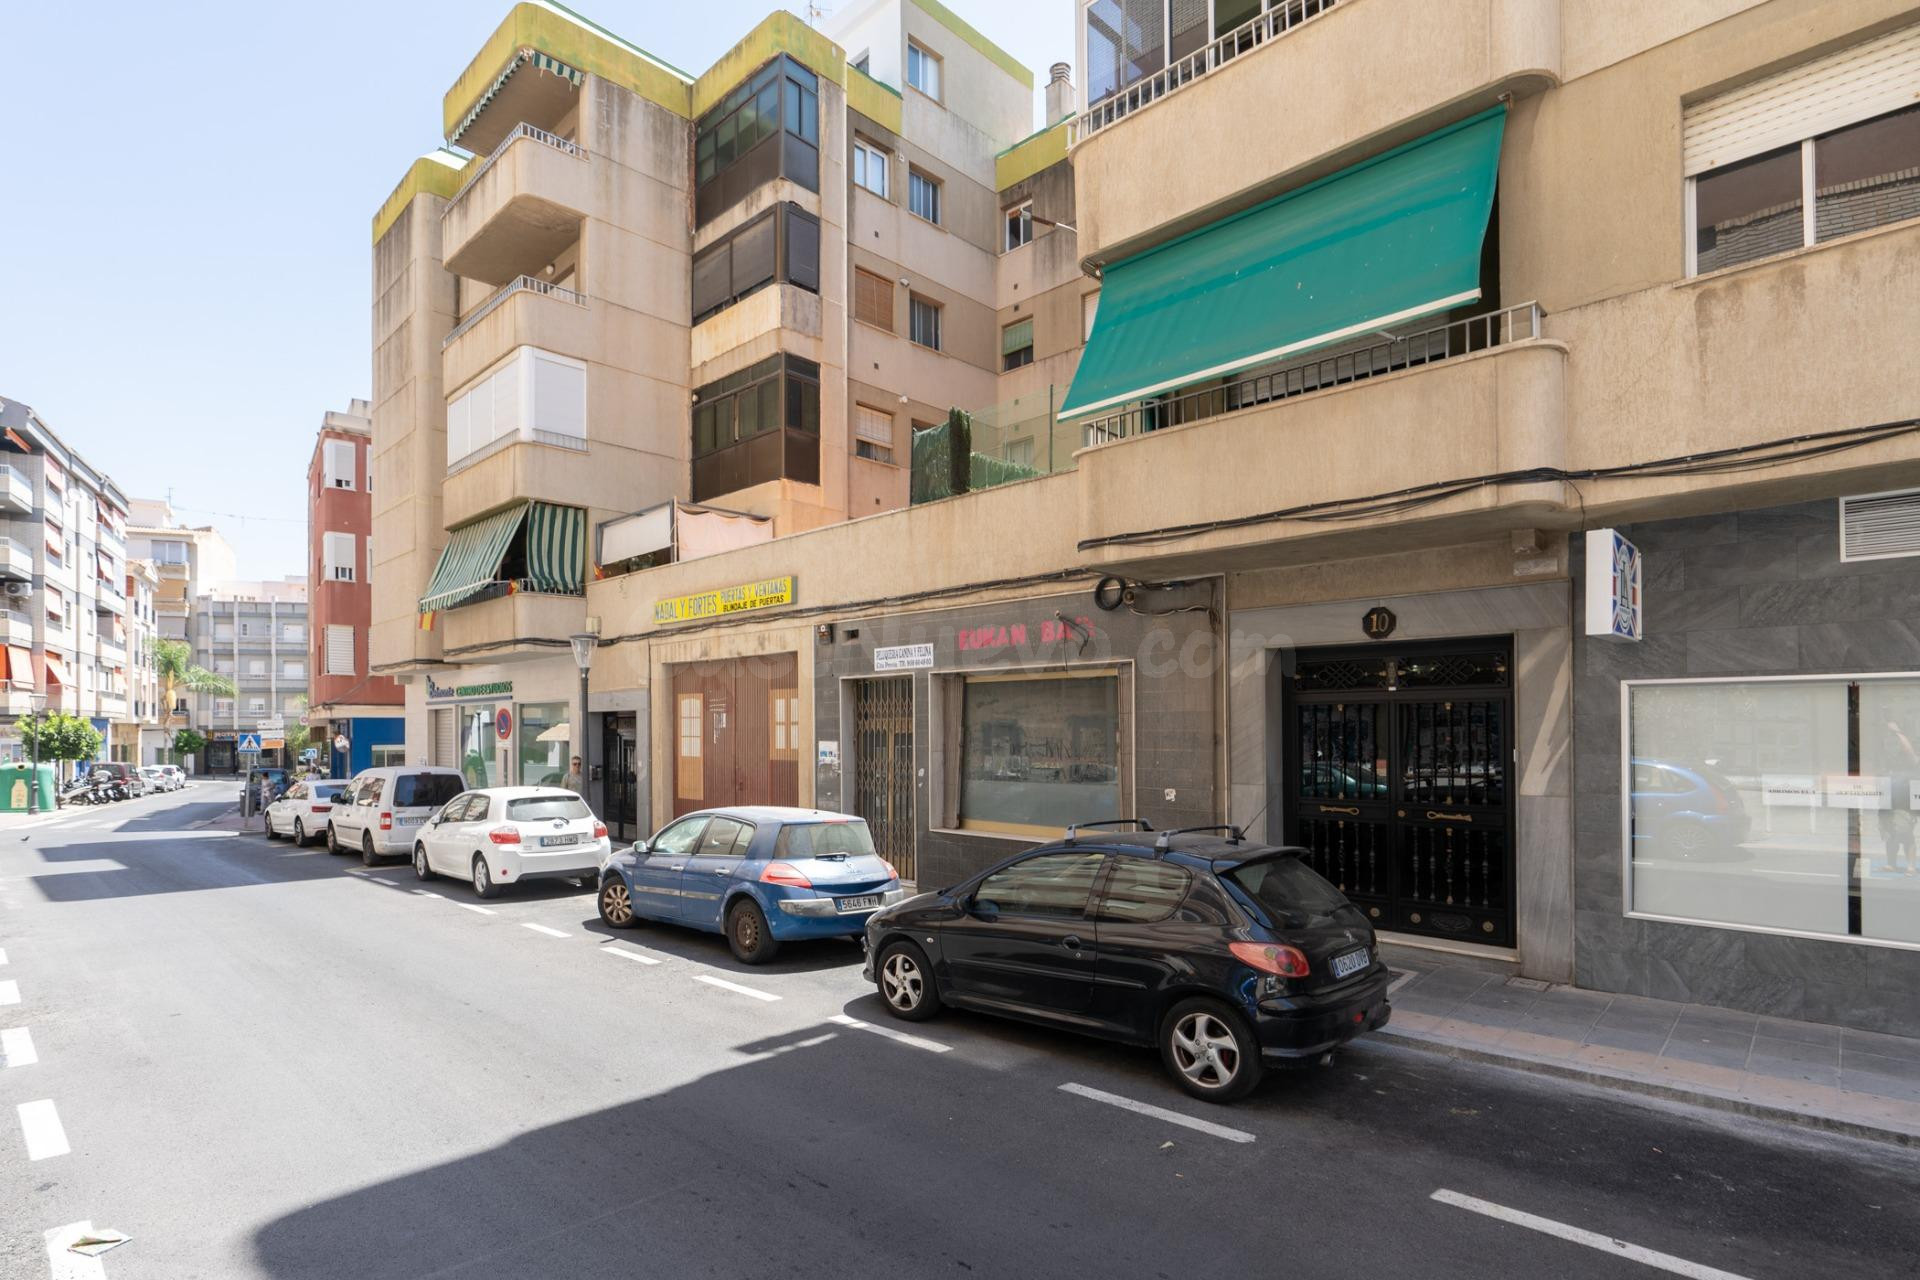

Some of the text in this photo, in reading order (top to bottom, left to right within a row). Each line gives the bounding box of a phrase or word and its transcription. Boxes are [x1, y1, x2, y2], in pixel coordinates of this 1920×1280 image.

[720, 586, 745, 602] PUERTAS
[754, 579, 787, 598] VENTANAS
[655, 594, 717, 620] NADAL Y FORTES
[723, 594, 785, 612] BLINDAJE DE PUERTAS
[1370, 612, 1389, 632] 10
